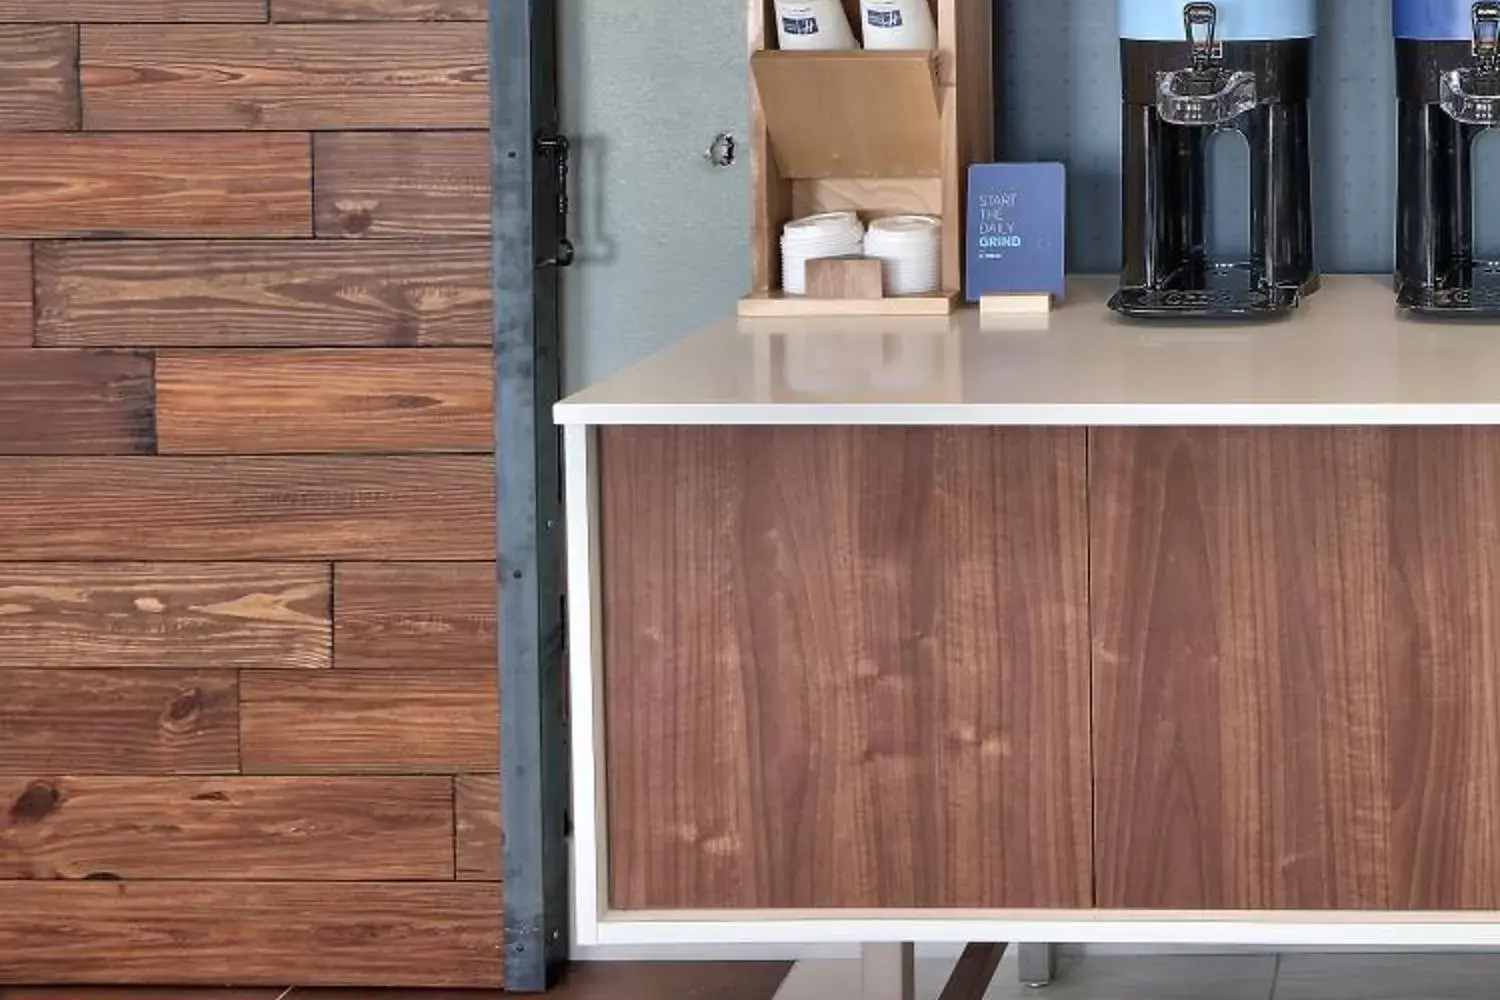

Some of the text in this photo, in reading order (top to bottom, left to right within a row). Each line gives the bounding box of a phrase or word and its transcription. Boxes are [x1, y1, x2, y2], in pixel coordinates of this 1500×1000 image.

[979, 193, 1018, 207] START
[980, 207, 1004, 221] THE
[980, 221, 1016, 235] DAILY
[979, 235, 1021, 247] GRIND
